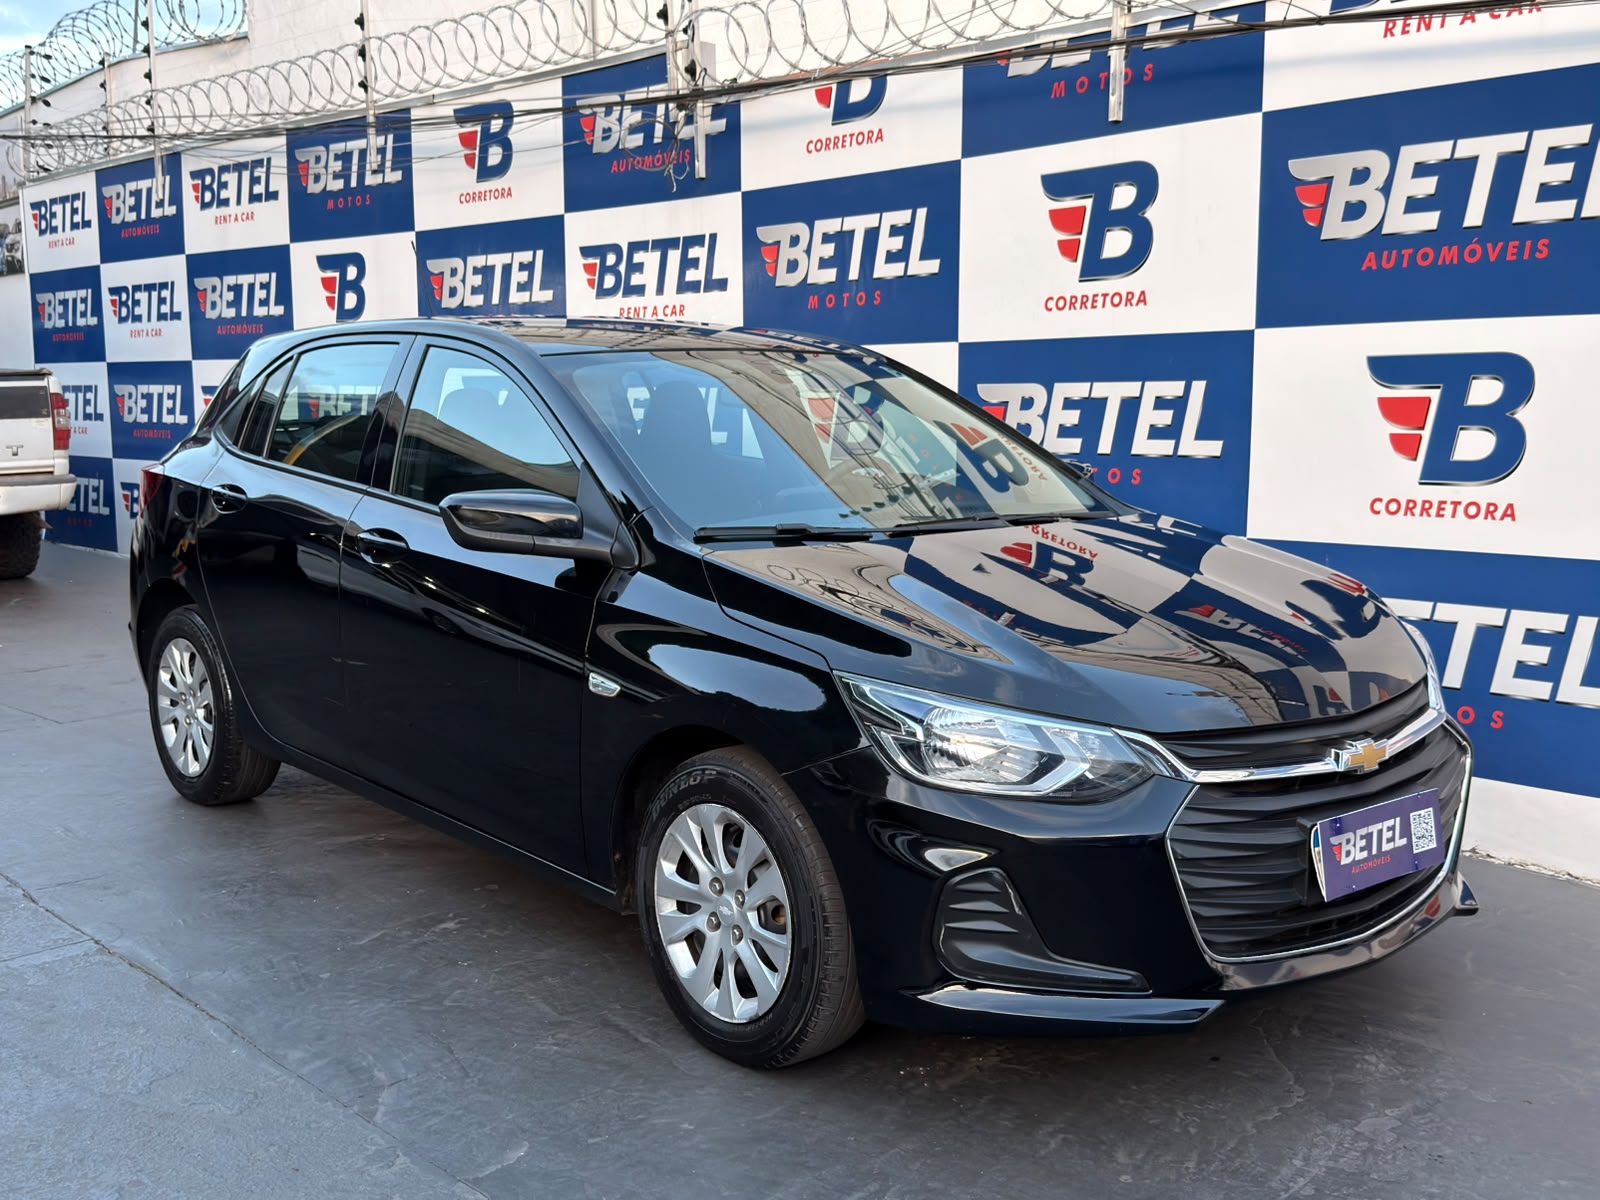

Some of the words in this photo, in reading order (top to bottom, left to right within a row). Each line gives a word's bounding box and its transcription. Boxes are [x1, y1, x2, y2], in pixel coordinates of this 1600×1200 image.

[806, 128, 884, 154] CORRETORA
[295, 133, 403, 194] BETEL
[102, 175, 177, 225] BETEL
[189, 157, 279, 211] BETEL
[326, 194, 371, 210] MOTOS
[459, 187, 513, 205] CORRETORA
[30, 191, 92, 237] BETEL
[215, 214, 232, 225] RENT
[234, 213, 239, 223] A
[241, 211, 255, 222] CAR
[579, 232, 729, 300] BETEL
[756, 207, 941, 288] BETEL
[1361, 237, 1551, 271] AUTOMÓVEIS
[193, 272, 285, 320] BETEL
[426, 249, 554, 309] BETEL
[36, 288, 98, 329] BETEL
[107, 280, 182, 325] BETEL
[619, 306, 648, 320] RENT
[651, 305, 659, 318] A
[662, 304, 685, 318] CAR
[808, 291, 881, 310] MOTOS
[1044, 290, 1148, 312] CORRETORA
[130, 329, 144, 339] RENT
[146, 329, 150, 338] A
[151, 328, 162, 338] CAR
[217, 323, 264, 335] AUTOMÓVEIS
[114, 384, 188, 424] BETEL
[977, 380, 1224, 458] BETEL
[1369, 497, 1517, 522] CORRETORA
[1330, 817, 1407, 865] BETEL
[1351, 855, 1392, 875] AUTOMÓVEIS
